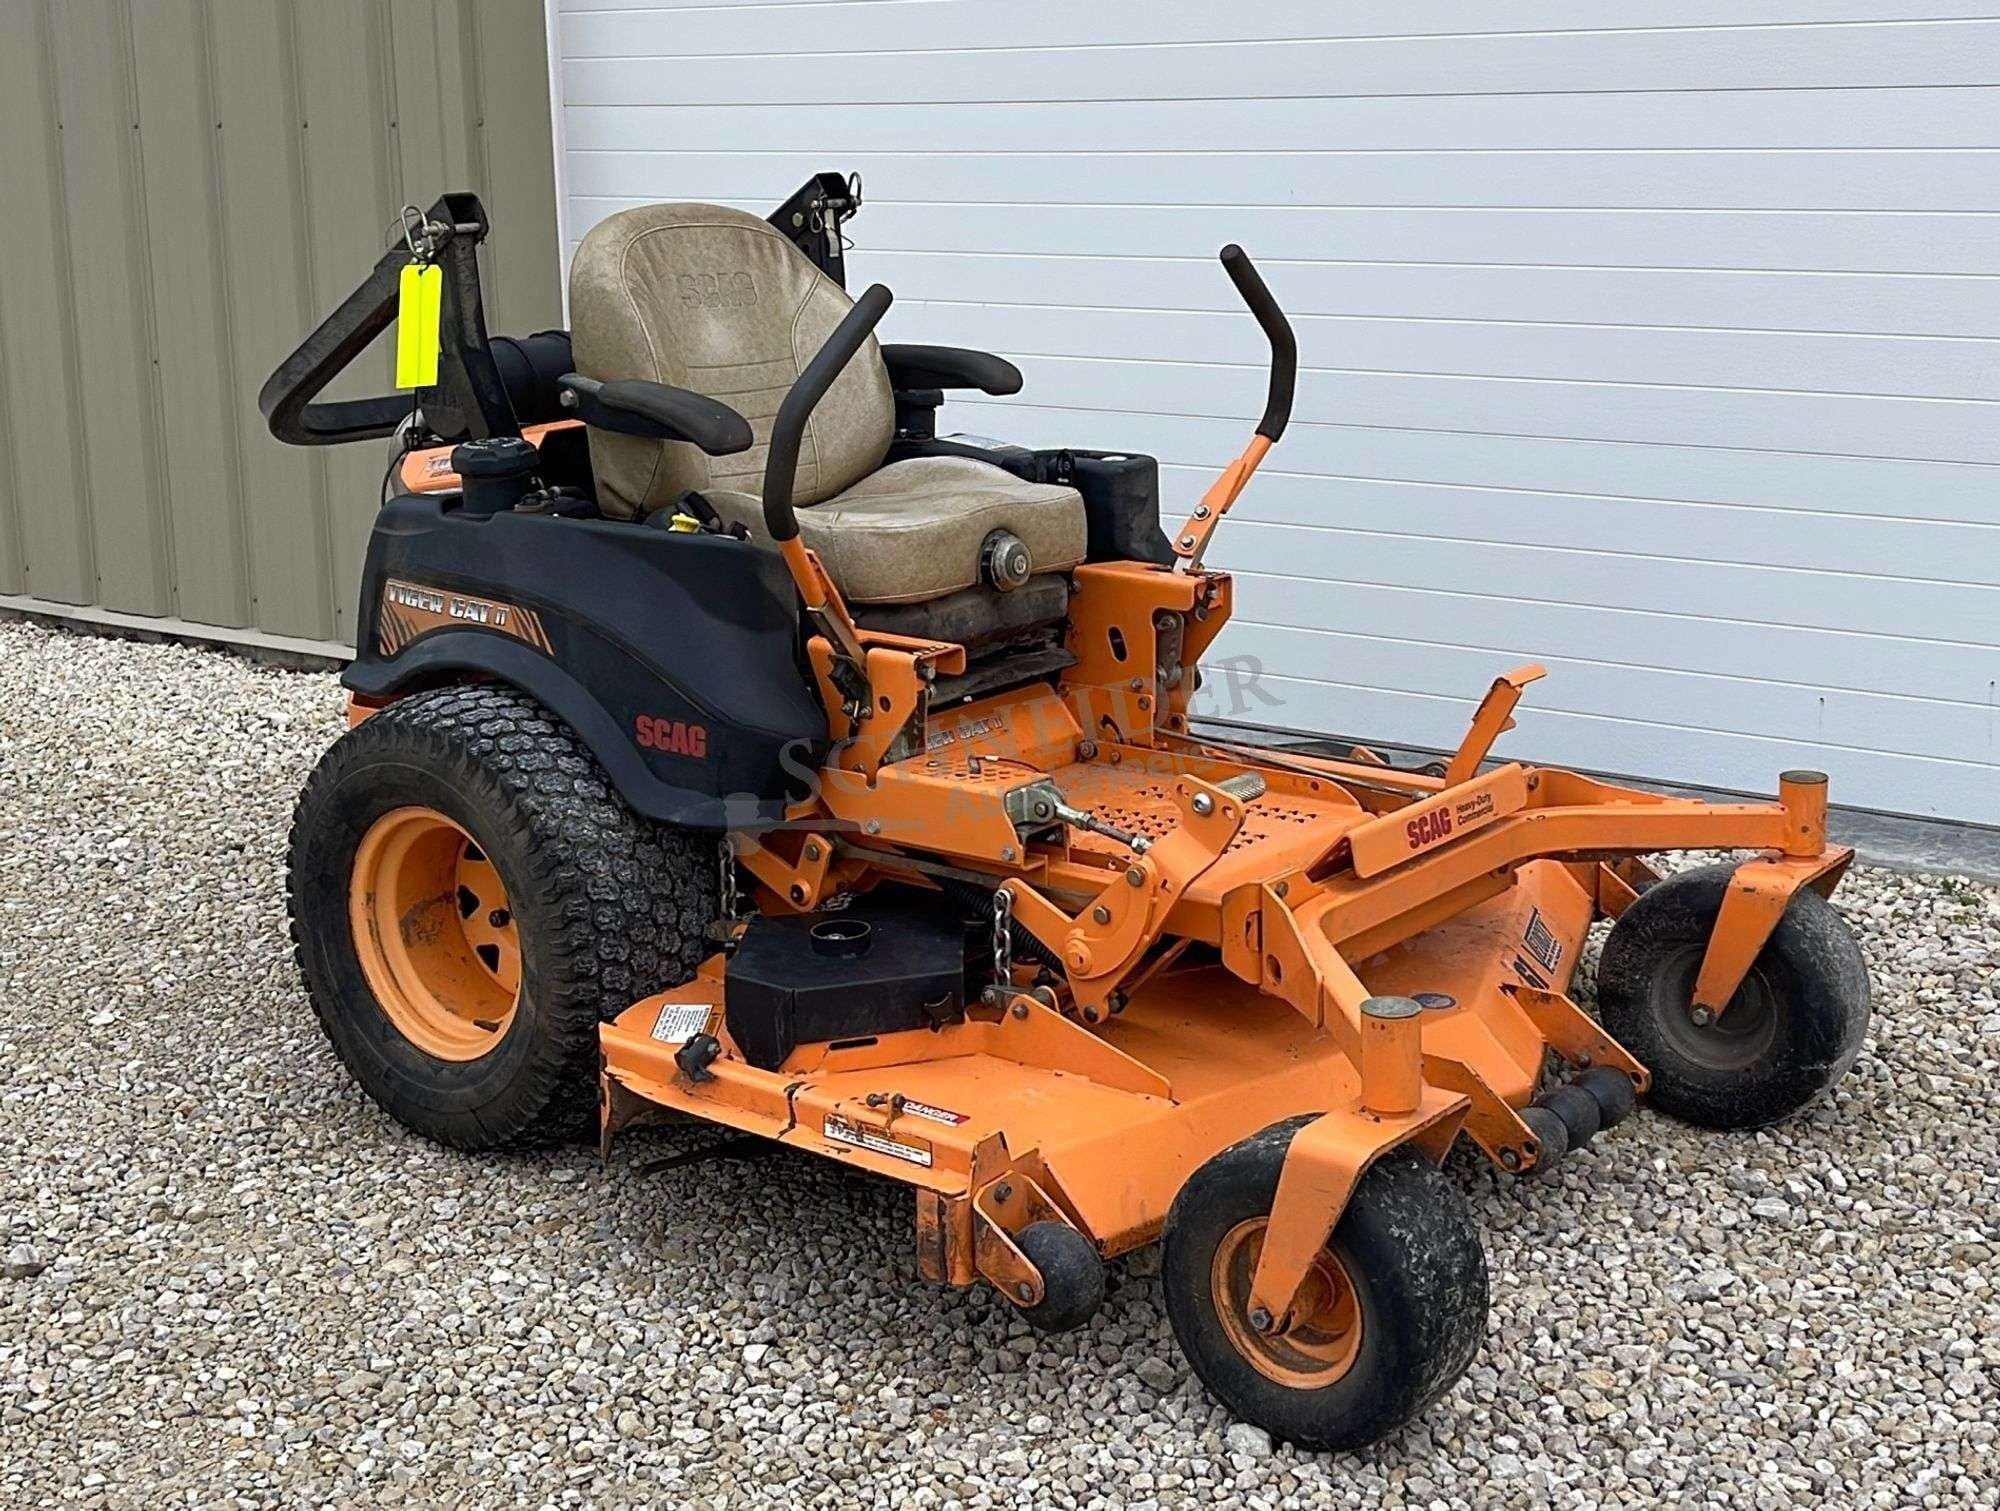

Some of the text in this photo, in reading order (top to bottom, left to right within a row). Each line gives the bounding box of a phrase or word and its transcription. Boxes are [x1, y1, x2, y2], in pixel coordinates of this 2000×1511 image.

[387, 583, 444, 614] TIGER
[449, 597, 493, 624] CAT
[635, 714, 708, 758] SCAG
[1455, 793, 1492, 815] Heavy-Duty
[1456, 804, 1495, 826] Commercial
[1406, 806, 1453, 850] SCAG
[903, 1100, 961, 1122] DANGER
